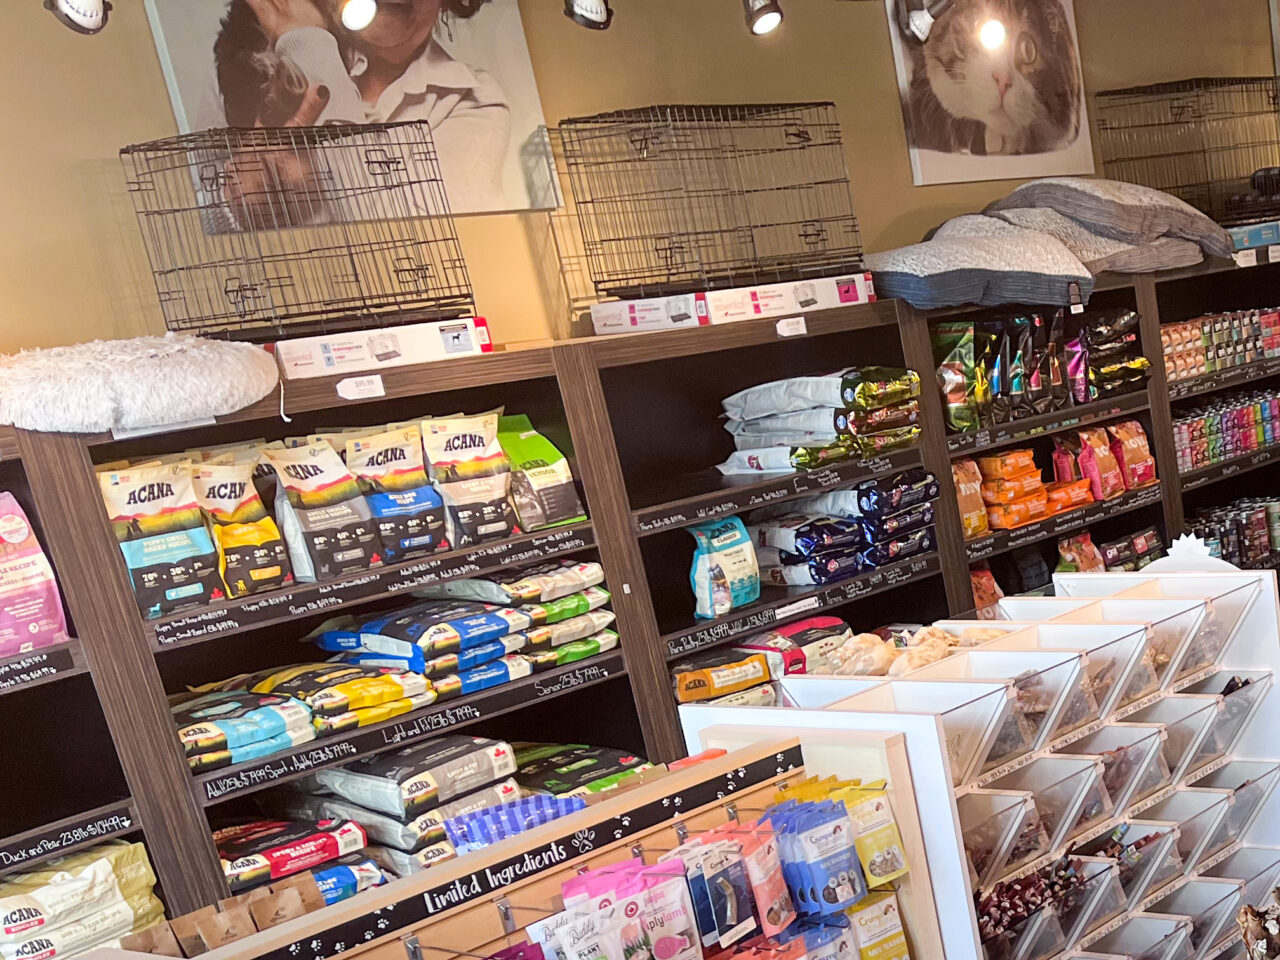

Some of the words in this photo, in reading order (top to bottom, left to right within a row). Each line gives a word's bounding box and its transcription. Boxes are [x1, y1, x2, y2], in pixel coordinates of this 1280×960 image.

[444, 434, 486, 452] ACANA
[365, 448, 407, 468] ACANA
[126, 483, 175, 505] ACANA
[534, 679, 562, 696] Senior
[407, 780, 430, 796] ACANA
[1, 846, 28, 866] Duck
[27, 843, 44, 858] and
[41, 838, 61, 855] Pear
[229, 856, 259, 872] ACANA
[424, 876, 482, 914] Limited
[488, 842, 567, 887] Ingredients
[3, 906, 42, 926] ACANA
[16, 938, 54, 957] ACANA
[578, 944, 600, 959] PLANT
